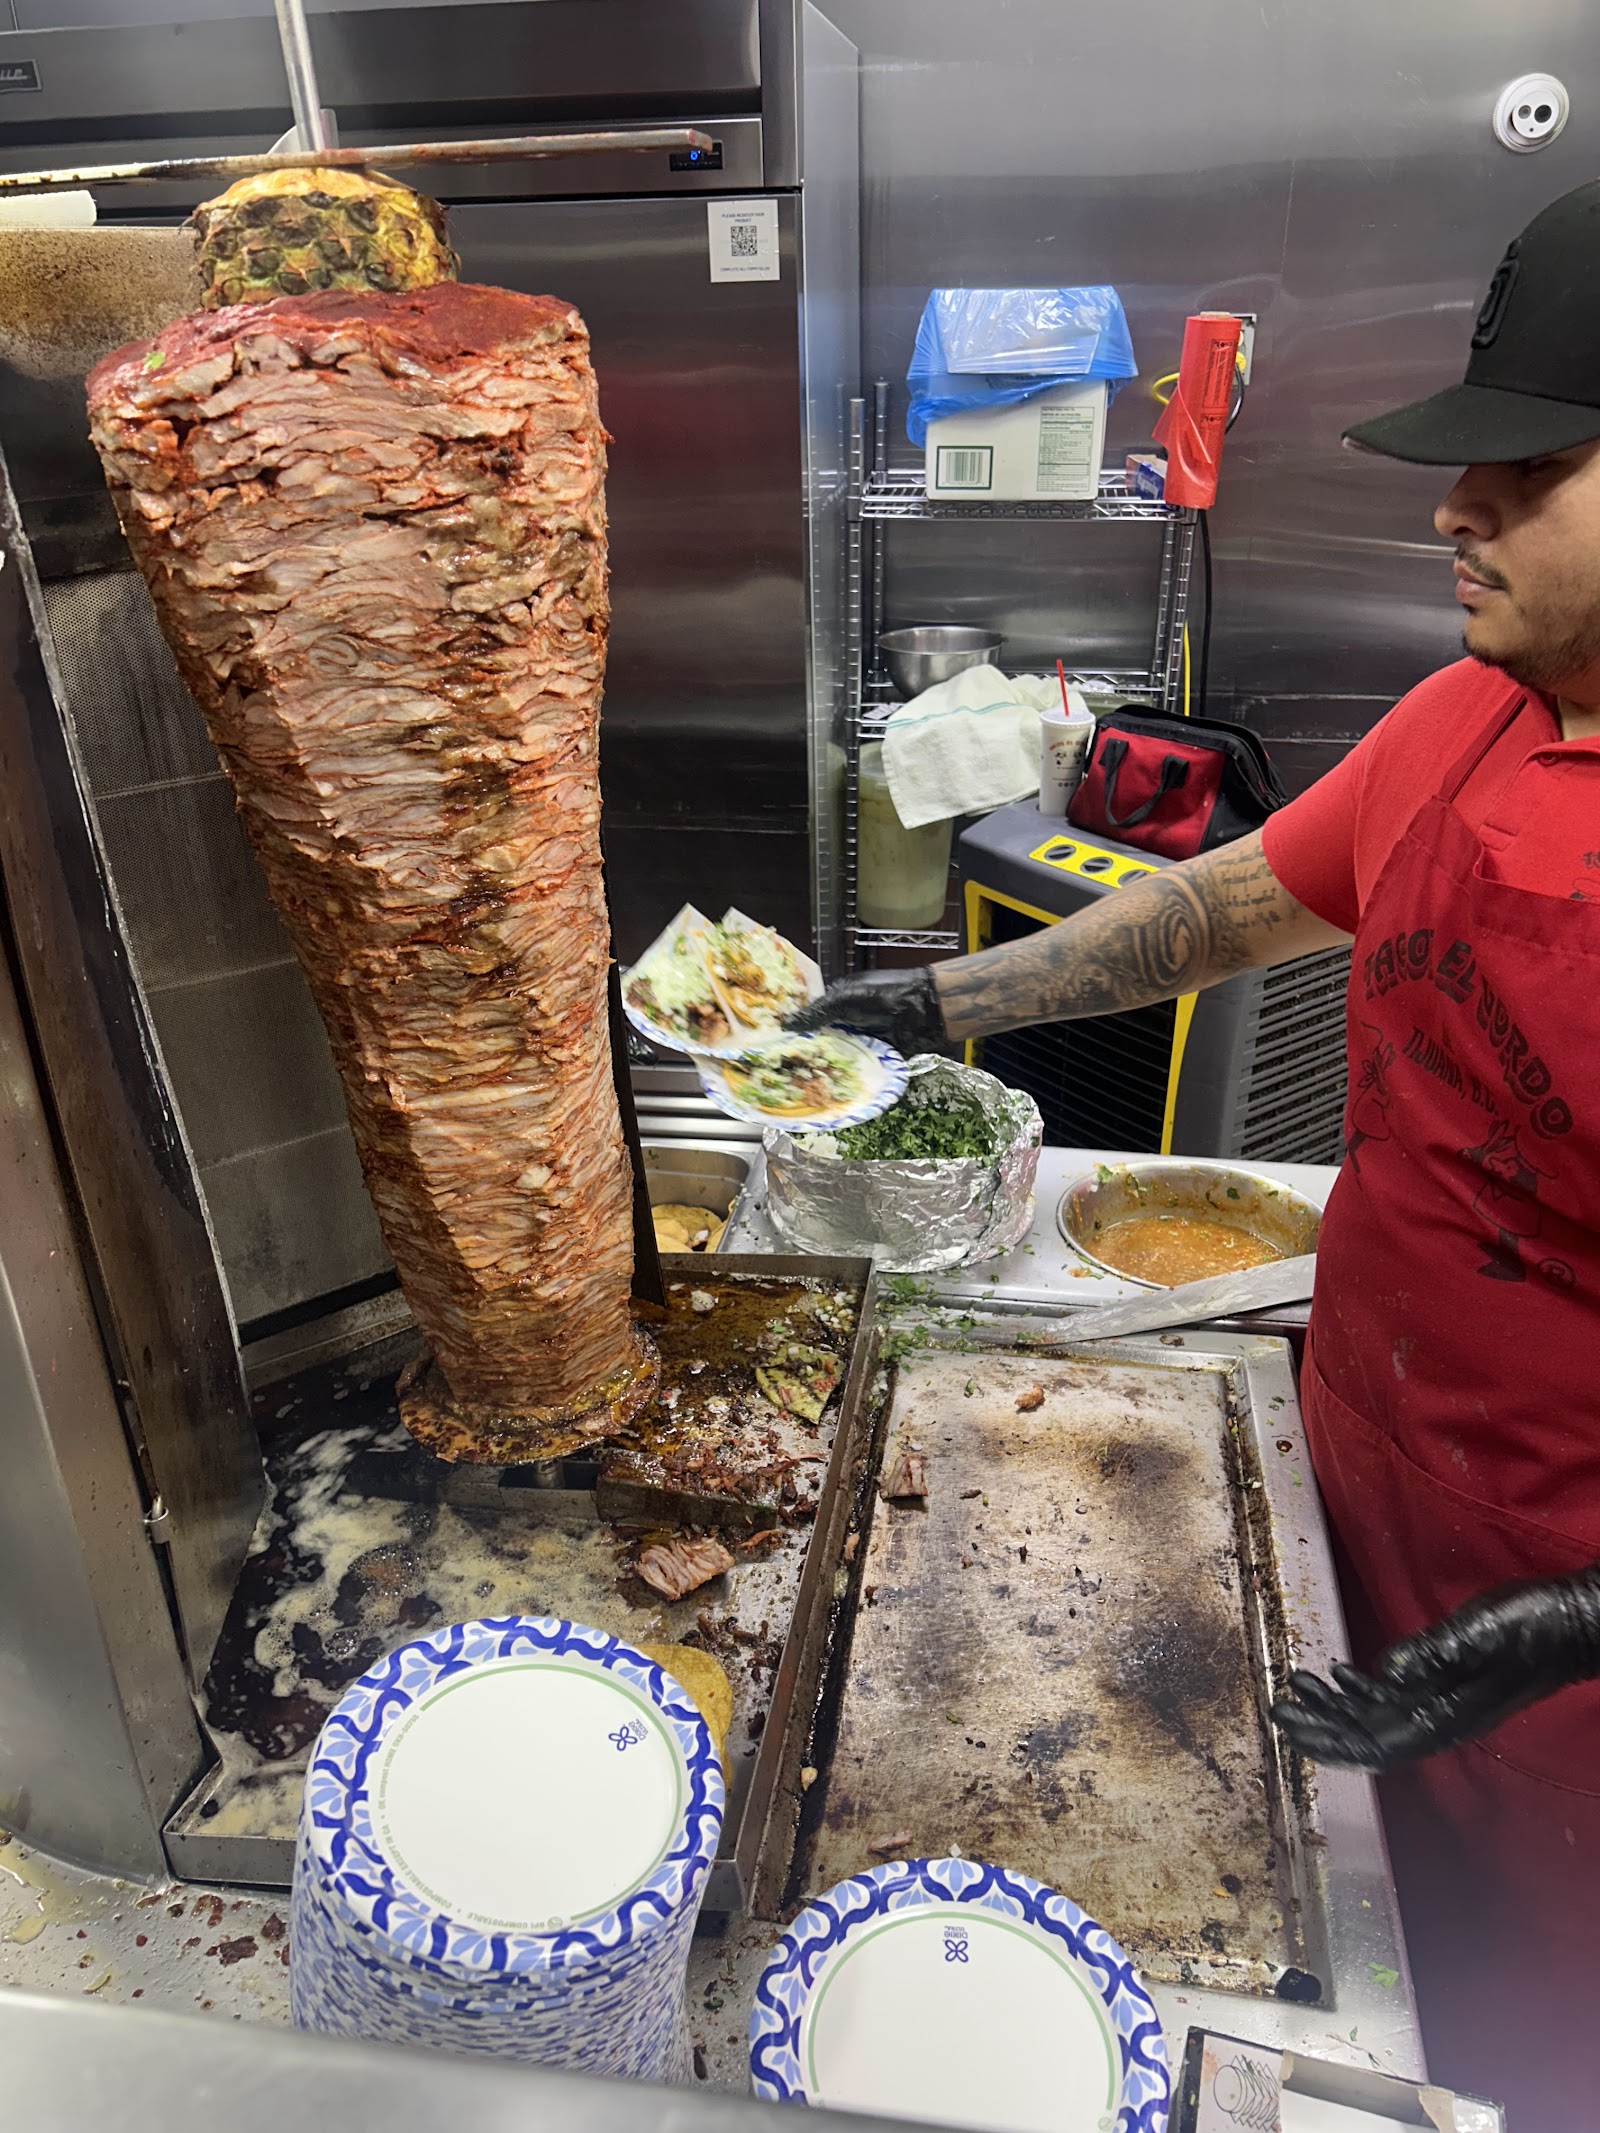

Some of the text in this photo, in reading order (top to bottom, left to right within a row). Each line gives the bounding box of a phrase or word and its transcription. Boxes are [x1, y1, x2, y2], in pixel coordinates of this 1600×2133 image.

[1363, 928, 1435, 1002] TACO
[1434, 940, 1477, 1005] EL
[389, 1844, 409, 1871] EXCEPT
[404, 1868, 453, 1909] COMPOSTABLE
[466, 1911, 528, 1929] COMPOSTABLE
